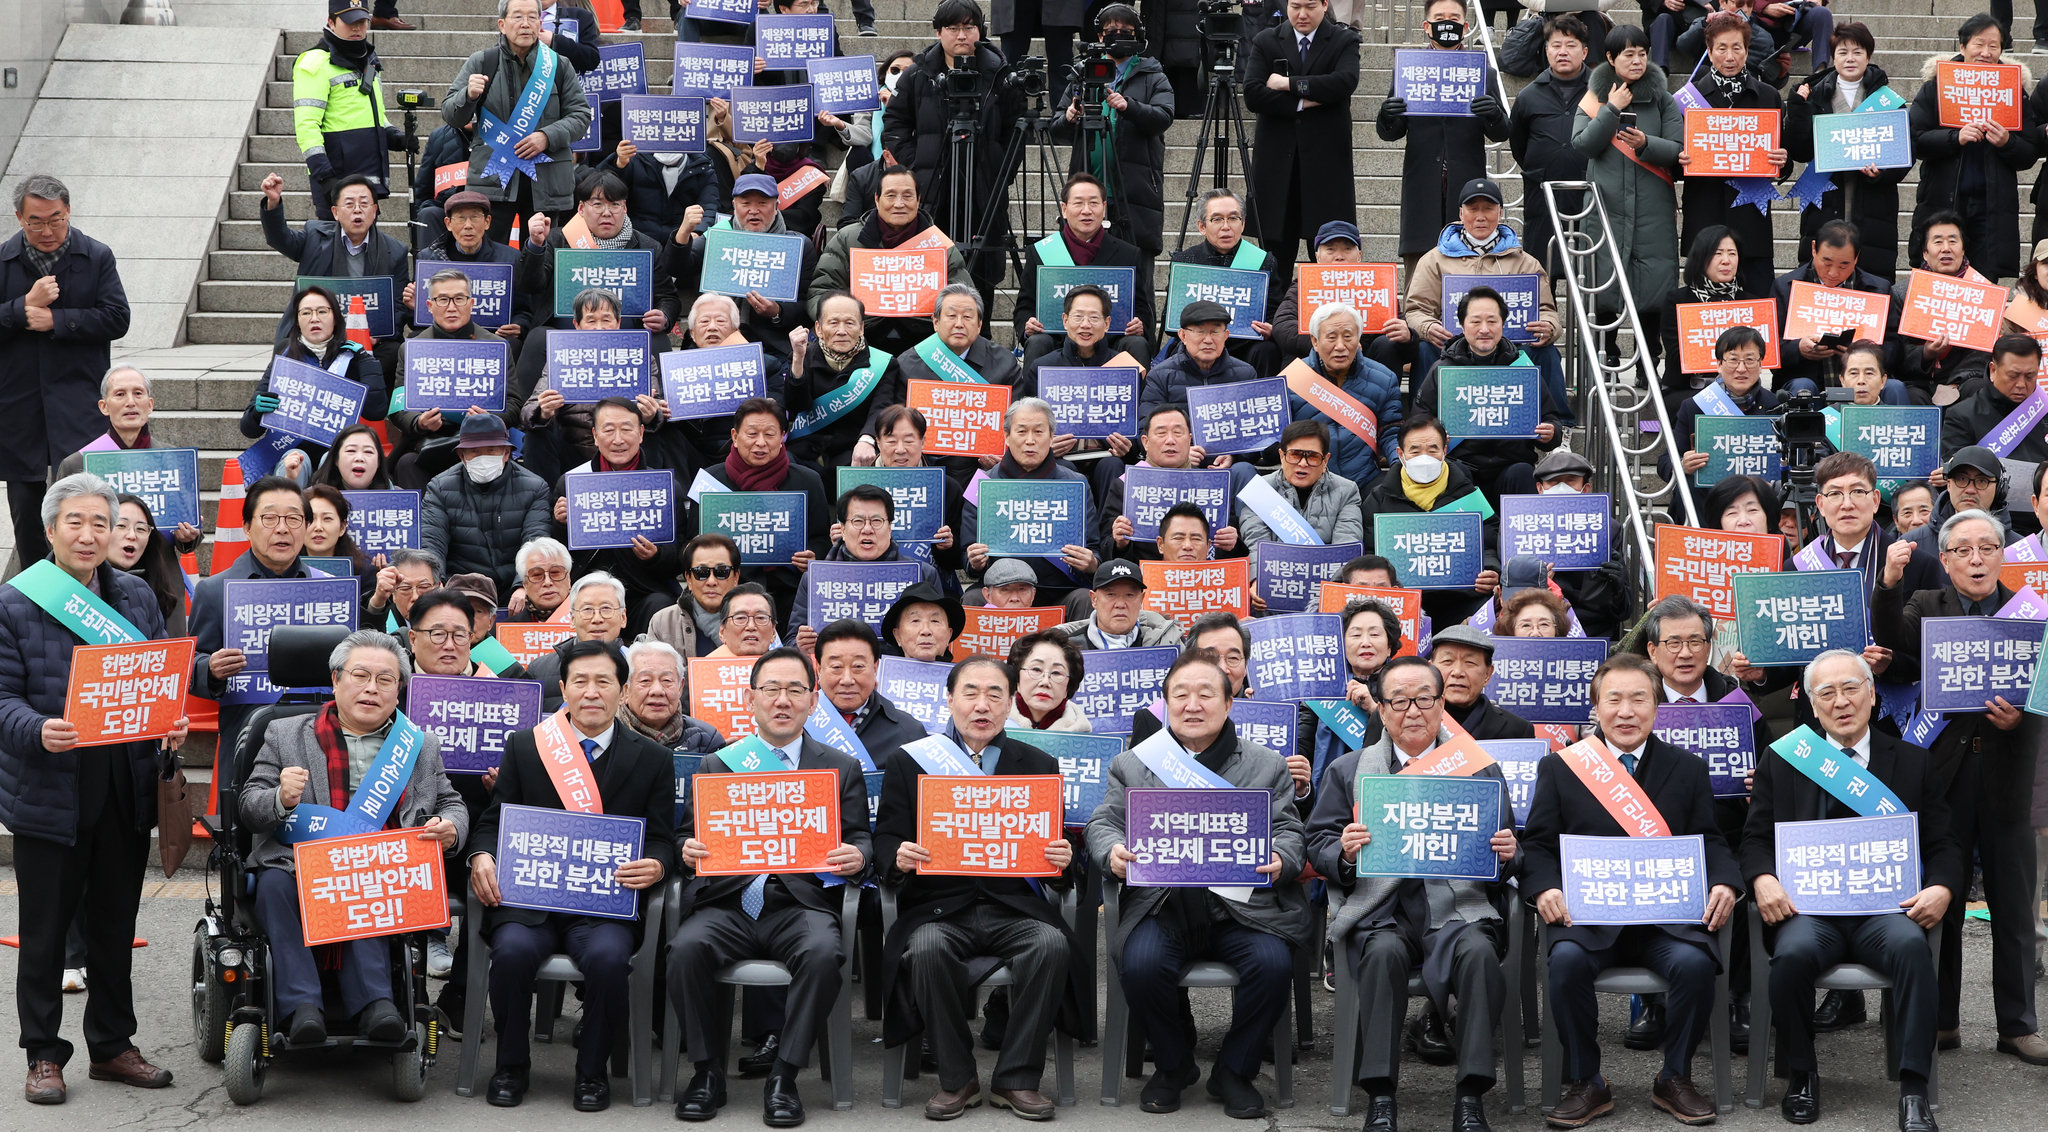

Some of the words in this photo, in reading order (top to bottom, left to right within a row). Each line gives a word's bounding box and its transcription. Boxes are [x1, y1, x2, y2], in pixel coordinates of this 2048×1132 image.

[762, 28, 794, 41] 제왕적
[797, 28, 828, 41] 대통령
[765, 43, 792, 58] 권한
[794, 42, 825, 58] 분산!
[680, 57, 713, 71] 제왕적
[715, 59, 748, 73] 대통령
[1401, 66, 1440, 81] 제왕적
[1443, 67, 1480, 82] 대통령
[683, 72, 710, 88] 권한
[712, 74, 747, 86] 분산!
[813, 71, 843, 86] 제왕적
[844, 69, 872, 83] 대통령
[1953, 69, 1999, 86] 헌법개정
[820, 86, 843, 103] 권한
[845, 84, 871, 99] 분산!
[1405, 83, 1437, 101] 권한
[1440, 84, 1475, 102] 분산!
[1943, 85, 2012, 106] 국민발안제
[737, 101, 771, 114] 제왕적
[774, 98, 807, 113] 대통령
[627, 109, 662, 123] 제왕적
[665, 110, 699, 124] 대통령
[741, 117, 769, 132] 권한
[772, 114, 803, 132] 분산!
[1706, 115, 1757, 131] 헌법개정
[631, 125, 660, 140] 권한
[662, 126, 695, 141] 분산!
[1692, 133, 1771, 151] 국민발안제
[1830, 125, 1894, 144] 지방분권
[1713, 153, 1750, 171] 도입!
[1844, 144, 1880, 160] 개헌!
[721, 248, 786, 269] 지방분권
[872, 255, 924, 271] 헌법개정
[571, 267, 636, 286] 지방분권
[731, 269, 770, 287] 개헌!
[858, 272, 938, 291] 국민발안제
[1321, 270, 1374, 286] 헌법개정
[879, 293, 917, 311] 도입!
[1186, 283, 1251, 306] 지방분권
[1814, 291, 1866, 311] 헌법개정
[1932, 280, 1987, 304] 헌법개정
[1699, 307, 1753, 325] 헌법개정
[1797, 306, 1878, 328] 국민발안제
[1914, 295, 1995, 331] 국민발안제
[1929, 319, 1969, 341] 도입!
[412, 357, 454, 374] 제왕적
[458, 358, 499, 375] 대통령
[554, 349, 597, 365] 제왕적
[601, 348, 643, 365] 대통령
[559, 368, 595, 387] 권한
[597, 367, 637, 387] 분산!
[669, 365, 712, 383] 제왕적
[714, 360, 757, 378] 대통령
[274, 376, 316, 401] 제왕적
[316, 389, 356, 415] 대통령
[417, 376, 452, 395] 권한
[454, 377, 494, 396] 분산!
[677, 383, 711, 404] 권한
[714, 379, 754, 400] 분산!
[1045, 385, 1087, 401] 제왕적
[1091, 385, 1131, 401] 대통령
[1456, 385, 1523, 405] 지방분권
[931, 388, 987, 408] 헌법개정
[1195, 401, 1237, 420] 제왕적
[1240, 395, 1282, 414] 대통령
[308, 406, 346, 433] 분산!
[1087, 404, 1126, 423] 분산!
[1469, 407, 1508, 426] 개헌!
[1202, 420, 1237, 442] 권한
[1240, 414, 1279, 437] 분산!
[1858, 425, 1925, 445] 지방분권
[935, 430, 976, 450] 도입!
[1713, 435, 1782, 454] 지방분권
[1871, 447, 1911, 467] 개헌!
[574, 491, 619, 509] 제왕적
[622, 489, 666, 507] 대통령
[1131, 486, 1177, 504] 제왕적
[996, 500, 1068, 520] 지방분권
[580, 511, 617, 532] 권한
[620, 509, 661, 530] 분산!
[718, 511, 789, 532] 지방분권
[1509, 514, 1554, 531] 제왕적
[1558, 513, 1602, 530] 대통령
[1010, 523, 1052, 543] 개헌!
[1394, 532, 1465, 553] 지방분권
[733, 534, 774, 553] 개헌!
[1514, 534, 1551, 554] 권한
[1554, 533, 1597, 554] 분산!
[1684, 536, 1752, 560] 헌법개정
[1264, 560, 1309, 578] 제왕적
[1409, 555, 1450, 576] 개헌!
[1164, 568, 1225, 587] 헌법개정
[816, 581, 862, 600] 제왕적
[1148, 587, 1241, 611] 국민발안제
[1269, 579, 1306, 599] 권한
[234, 603, 290, 625] 제왕적
[295, 601, 349, 624] 대통령
[1756, 594, 1844, 622] 지방분권
[977, 615, 1039, 633] 헌법개정
[1776, 624, 1827, 649] 개헌!
[1250, 636, 1294, 661] 제왕적
[1297, 635, 1338, 654] 대통령
[1932, 640, 1989, 663] 제왕적
[102, 649, 167, 677] 헌법개정
[1256, 659, 1293, 688] 권한
[1297, 658, 1335, 681] 분산!
[1547, 660, 1598, 680] 대통령
[1938, 665, 1986, 691] 권한
[79, 673, 179, 708] 국민발안제
[1496, 682, 1539, 705] 권한
[1542, 683, 1591, 706] 분산!
[101, 707, 150, 734] 도입!
[429, 700, 519, 725] 지역대표형
[727, 781, 805, 805] 헌법개정
[951, 786, 1029, 808] 헌법개정
[707, 806, 827, 837] 국민발안제
[930, 812, 1050, 839] 국민발안제
[1150, 812, 1247, 834] 지역대표형
[1383, 802, 1478, 831] 지방분권
[328, 839, 408, 871] 헌법개정
[508, 832, 568, 859] 제왕적
[572, 839, 632, 867] 대통령
[740, 838, 796, 866] 도입!
[961, 842, 1017, 869] 도입!
[1131, 837, 1203, 864] 상원제
[1208, 838, 1265, 864] 도입!
[1401, 833, 1457, 860] 개헌!
[1786, 844, 1845, 867] 제왕적
[1850, 839, 1908, 864] 대통령
[513, 859, 562, 889] 권한
[1572, 858, 1630, 879] 제왕적
[1635, 857, 1694, 878] 대통령
[311, 866, 432, 907] 국민발안제
[1794, 869, 1842, 895] 권한
[1846, 865, 1901, 894] 분산!
[1580, 881, 1628, 905] 권한
[1632, 880, 1688, 905] 분산!
[347, 898, 403, 929] 도입!
